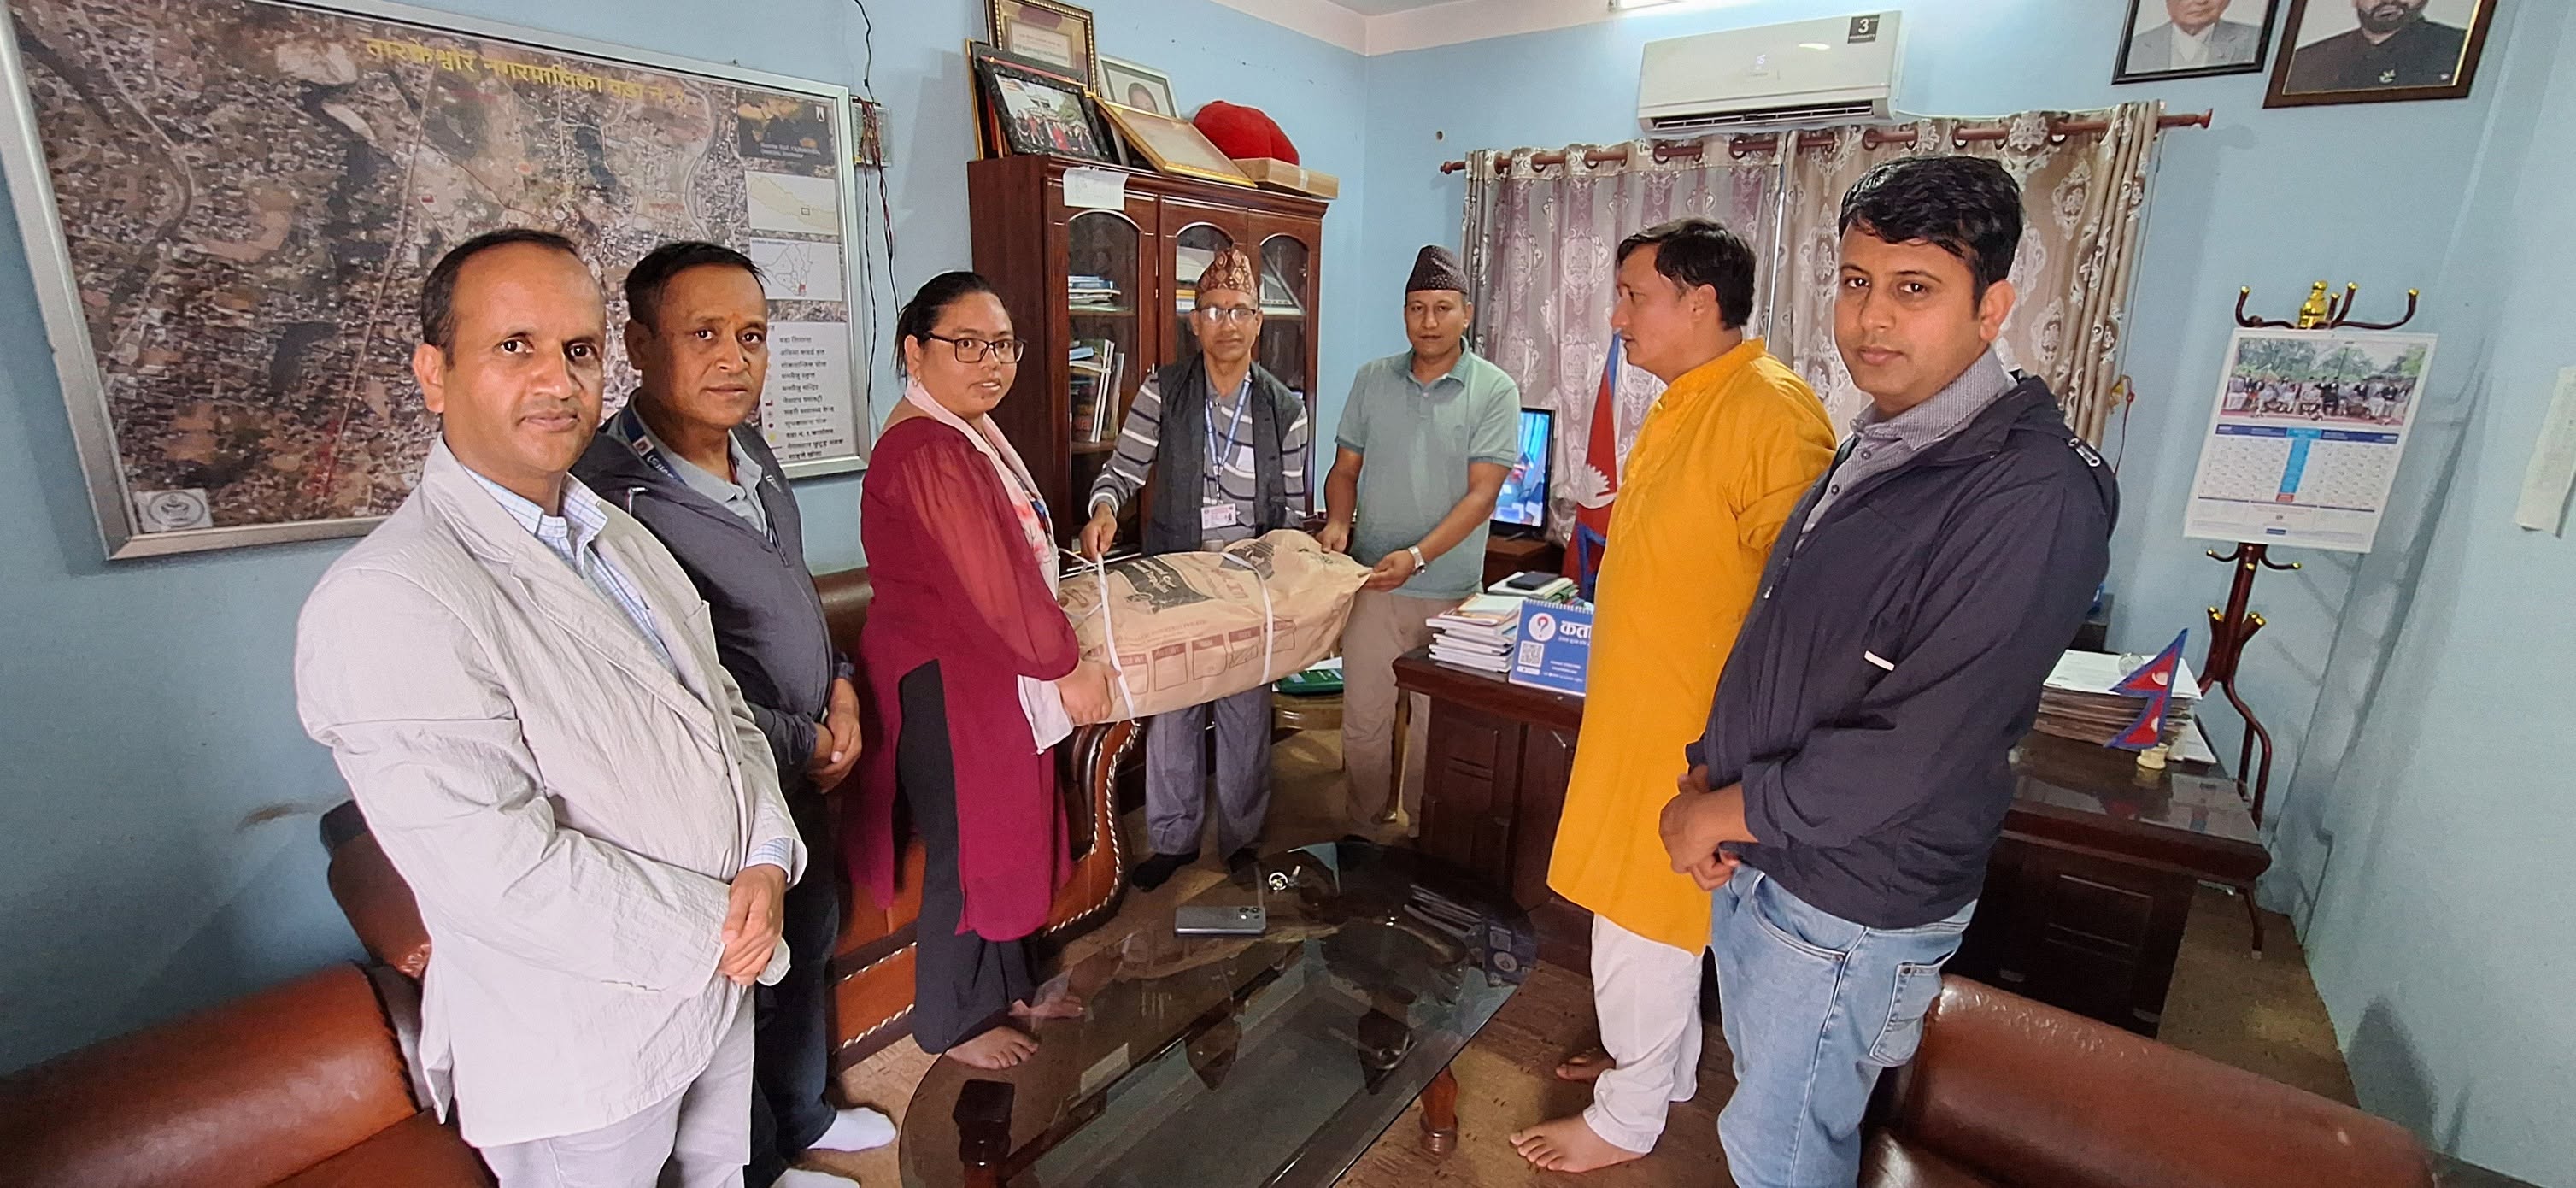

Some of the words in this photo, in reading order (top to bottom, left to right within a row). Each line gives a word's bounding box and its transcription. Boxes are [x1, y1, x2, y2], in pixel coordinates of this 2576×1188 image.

[1858, 18, 1869, 33] 3
[484, 59, 602, 93] नगरपालिका
[607, 79, 644, 99] वडा
